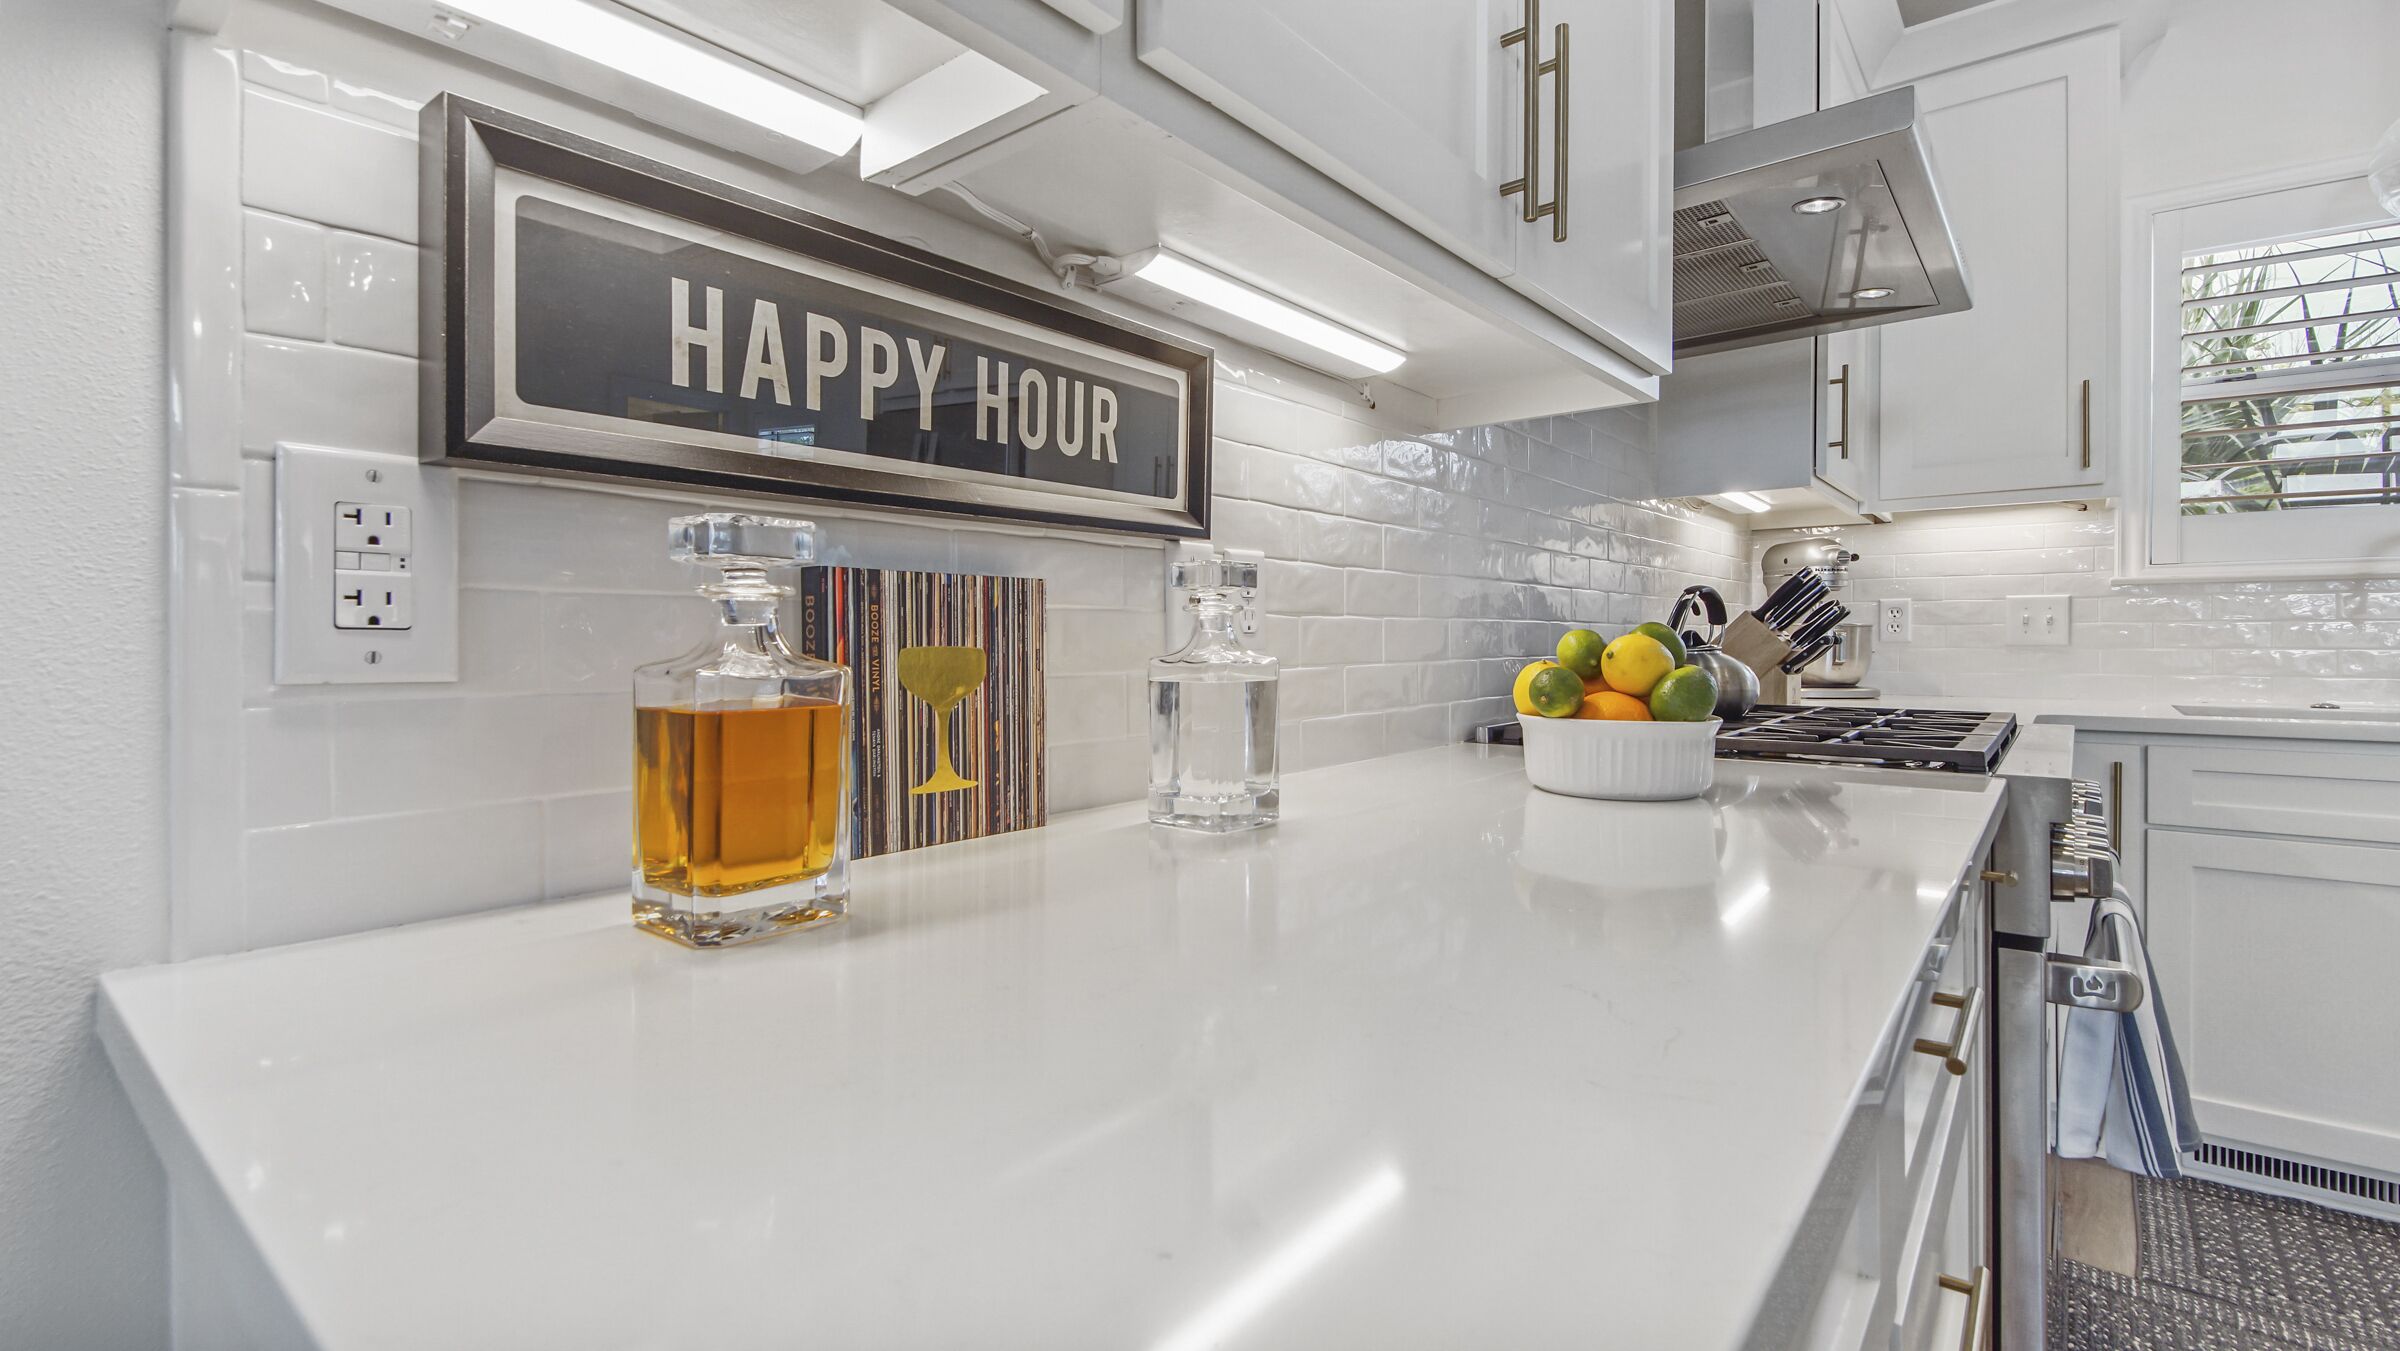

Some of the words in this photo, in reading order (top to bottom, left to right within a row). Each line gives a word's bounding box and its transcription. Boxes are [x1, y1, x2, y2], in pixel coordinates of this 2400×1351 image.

[672, 277, 946, 431] HAPPY
[976, 356, 1118, 464] HOUR
[870, 604, 880, 643] BOOZE
[871, 659, 880, 693] VINYL
